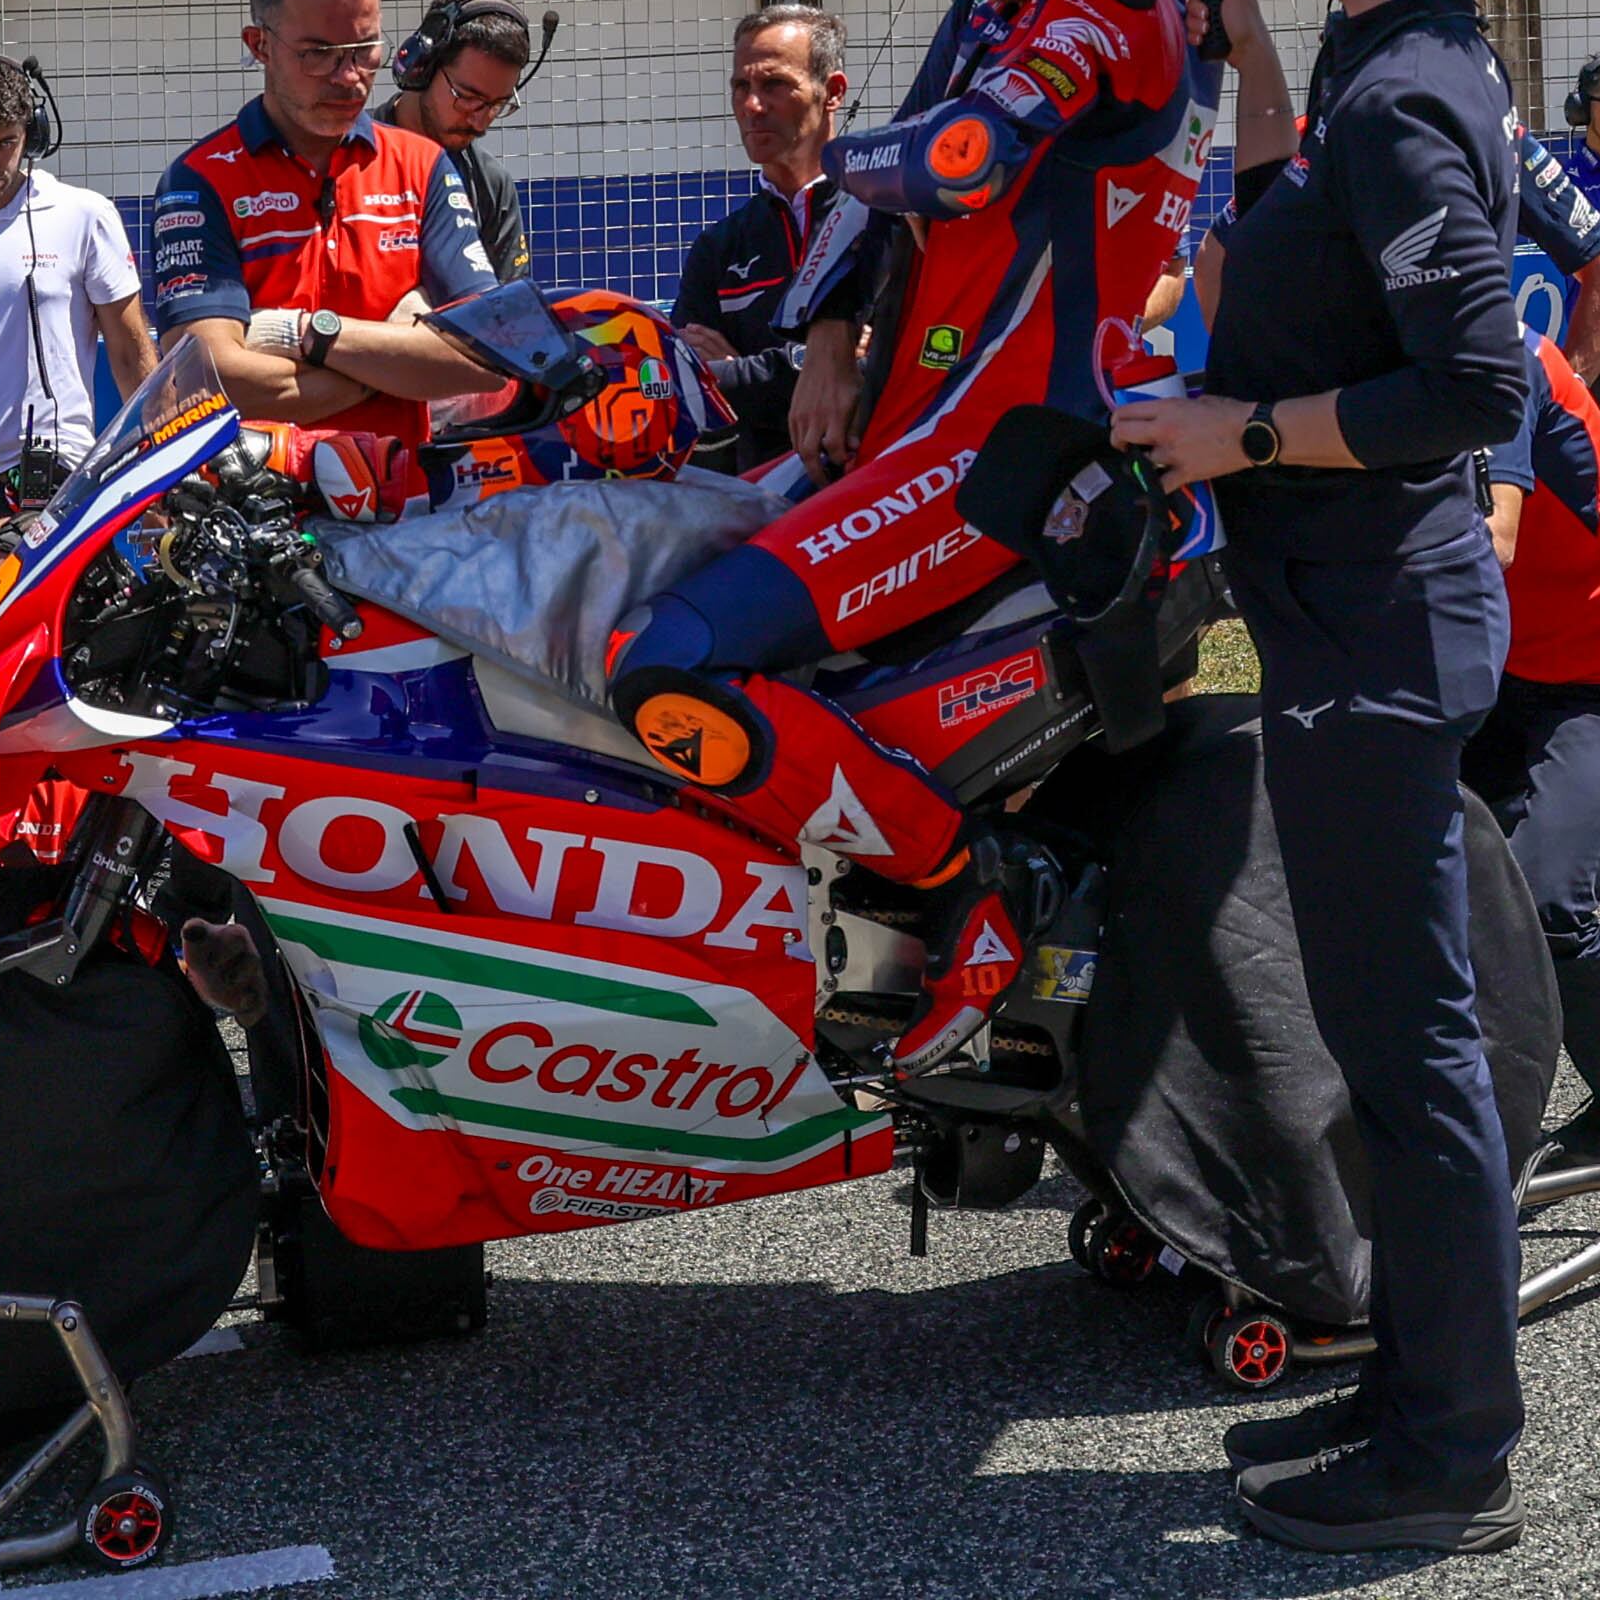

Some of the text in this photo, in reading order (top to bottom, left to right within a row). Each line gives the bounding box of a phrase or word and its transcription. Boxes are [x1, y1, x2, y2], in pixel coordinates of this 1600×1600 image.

[1031, 36, 1091, 81] HONDA
[844, 147, 868, 173] Satu
[802, 210, 842, 286] Castrol
[1384, 264, 1462, 291] HONDA
[153, 392, 228, 445] MARINI
[643, 381, 670, 399] agv
[797, 448, 979, 565] HONDA
[837, 521, 984, 622] DAINES
[937, 653, 1035, 722] HRC
[994, 702, 1094, 777] Honda Dream
[119, 750, 816, 963] HONDA
[962, 966, 1000, 996] 10
[467, 1021, 811, 1121] Castrol
[517, 1154, 593, 1189] One
